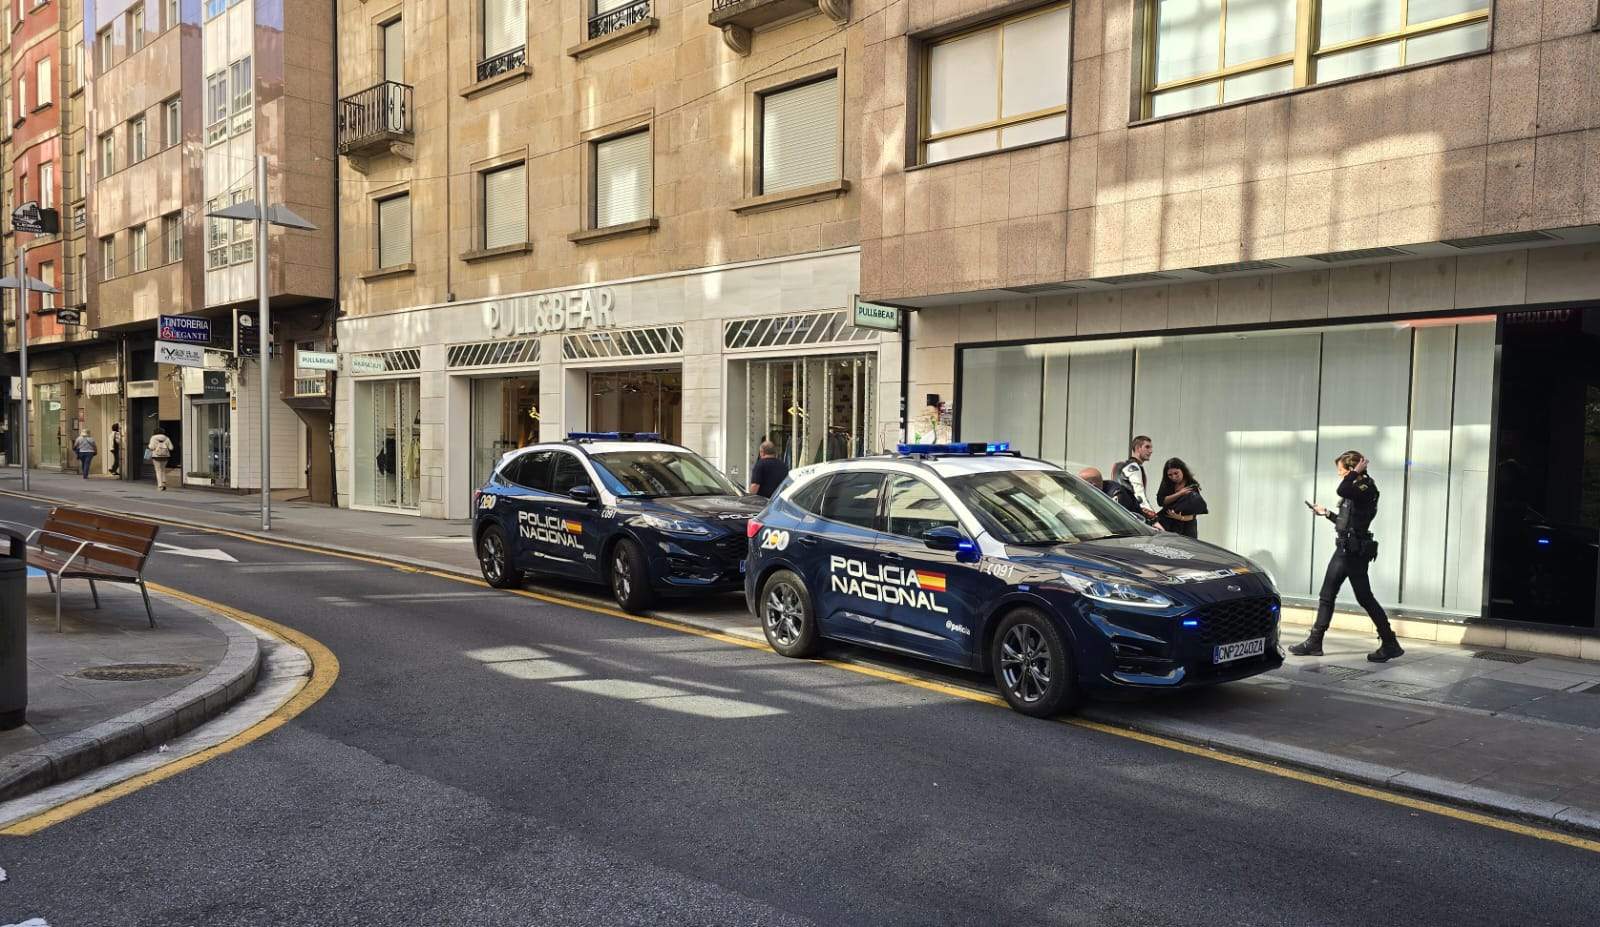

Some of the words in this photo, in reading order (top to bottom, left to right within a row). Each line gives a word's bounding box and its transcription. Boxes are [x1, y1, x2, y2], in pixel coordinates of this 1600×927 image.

[163, 317, 209, 330] TINTORERIA
[483, 287, 616, 338] PULL&BEAR
[858, 306, 895, 319] PULL&BEAR
[518, 511, 569, 533] POLICIA
[519, 525, 584, 550] NACIONAL
[830, 555, 922, 589] POLICIA
[831, 575, 949, 614] NACIONAL
[945, 620, 971, 636] @policia
